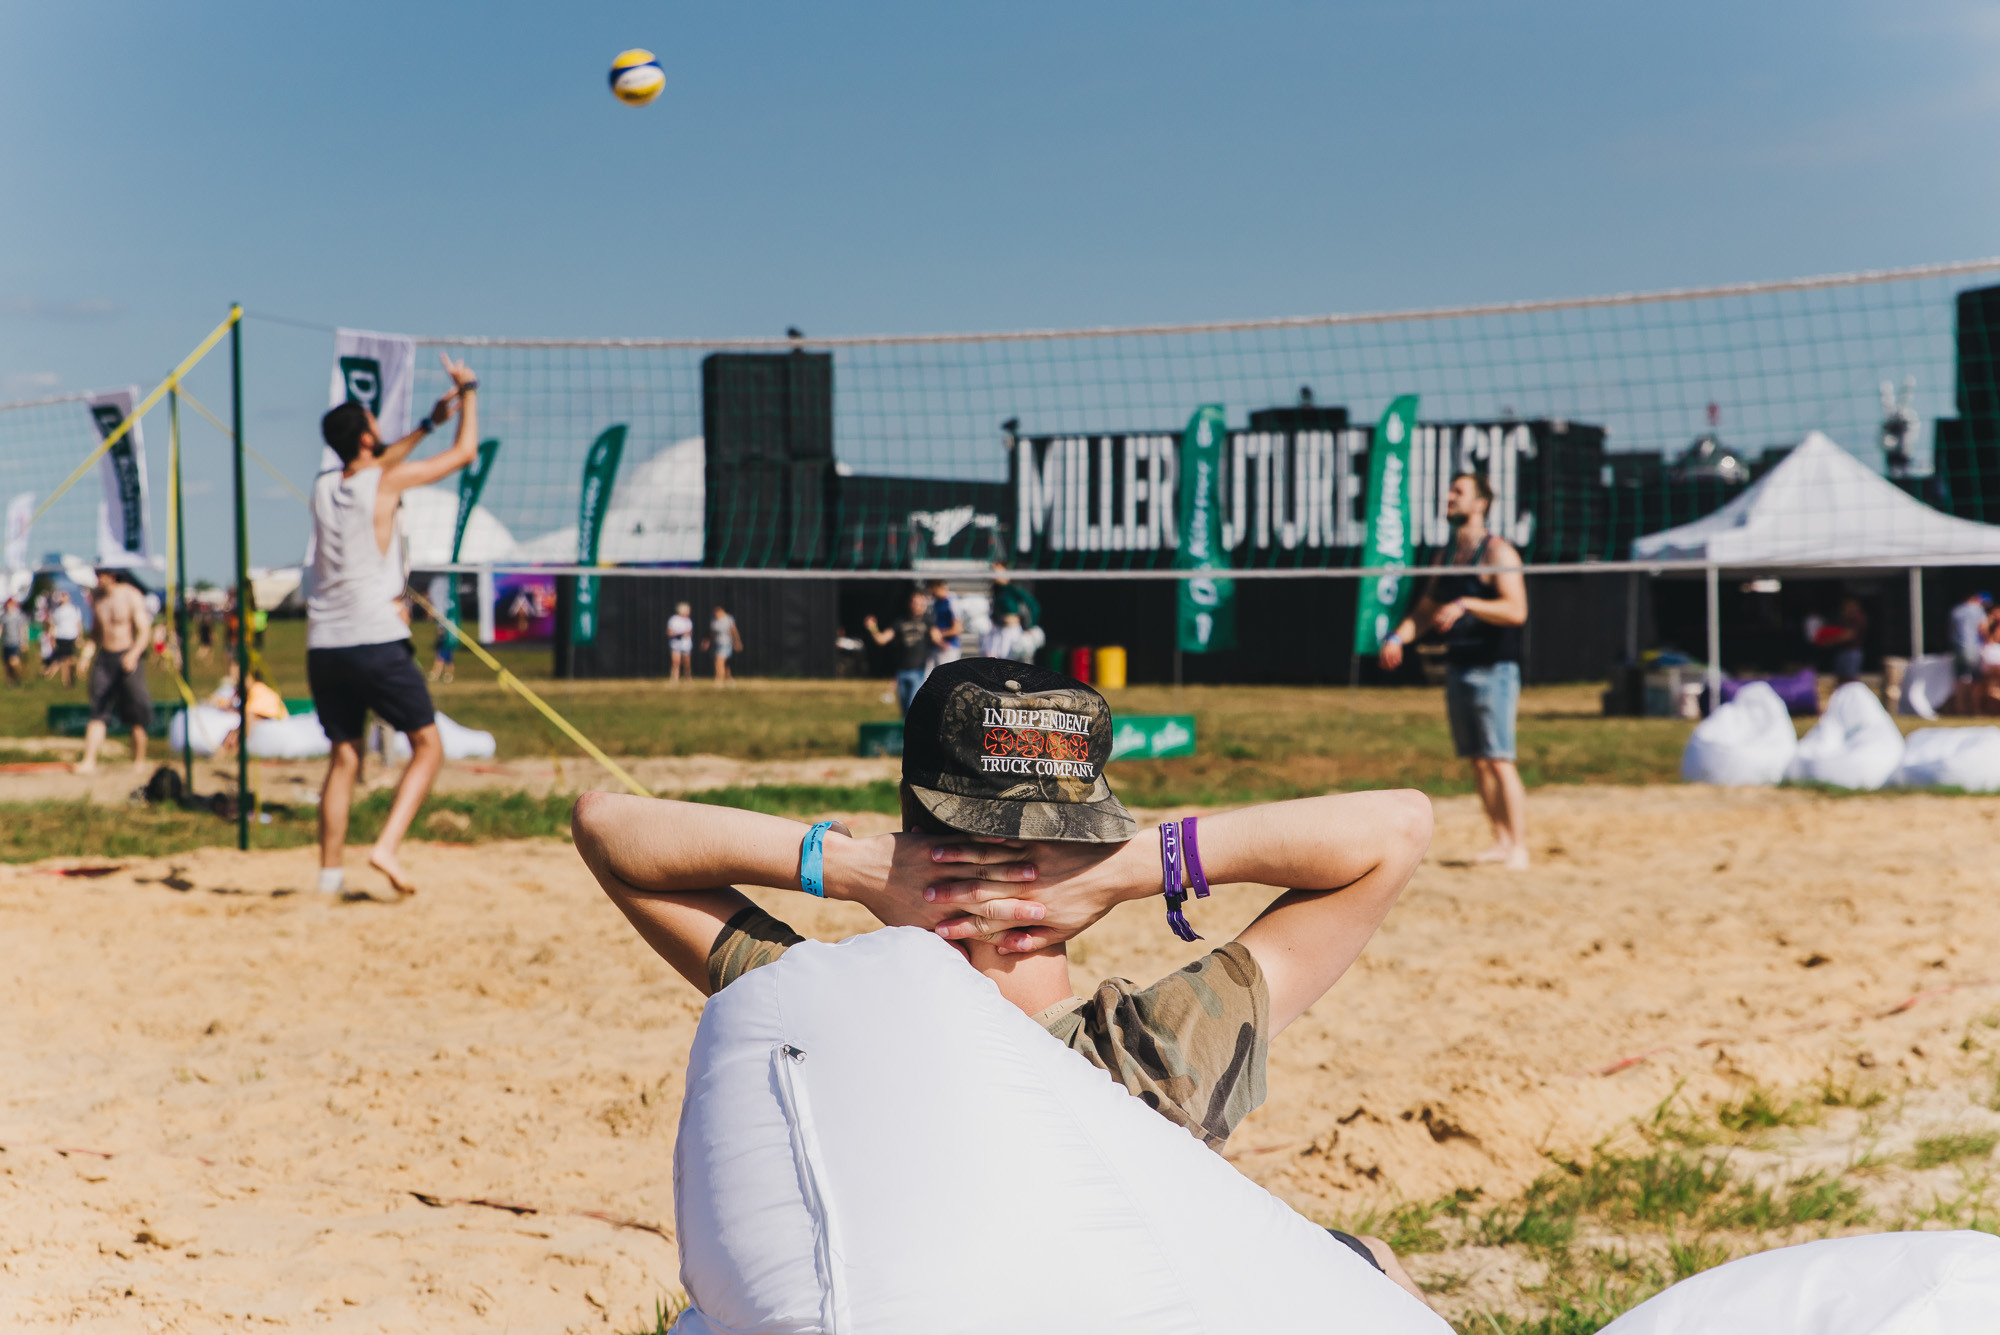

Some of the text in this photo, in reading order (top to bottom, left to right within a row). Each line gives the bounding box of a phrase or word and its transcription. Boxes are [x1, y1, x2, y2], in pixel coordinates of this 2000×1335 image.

[1018, 433, 1180, 552] MILLER
[1222, 430, 1368, 551] UTURE
[1410, 424, 1537, 548] UIC
[984, 708, 1092, 732] INDEPENDENT
[983, 759, 1094, 777] TRUCK COMPANY
